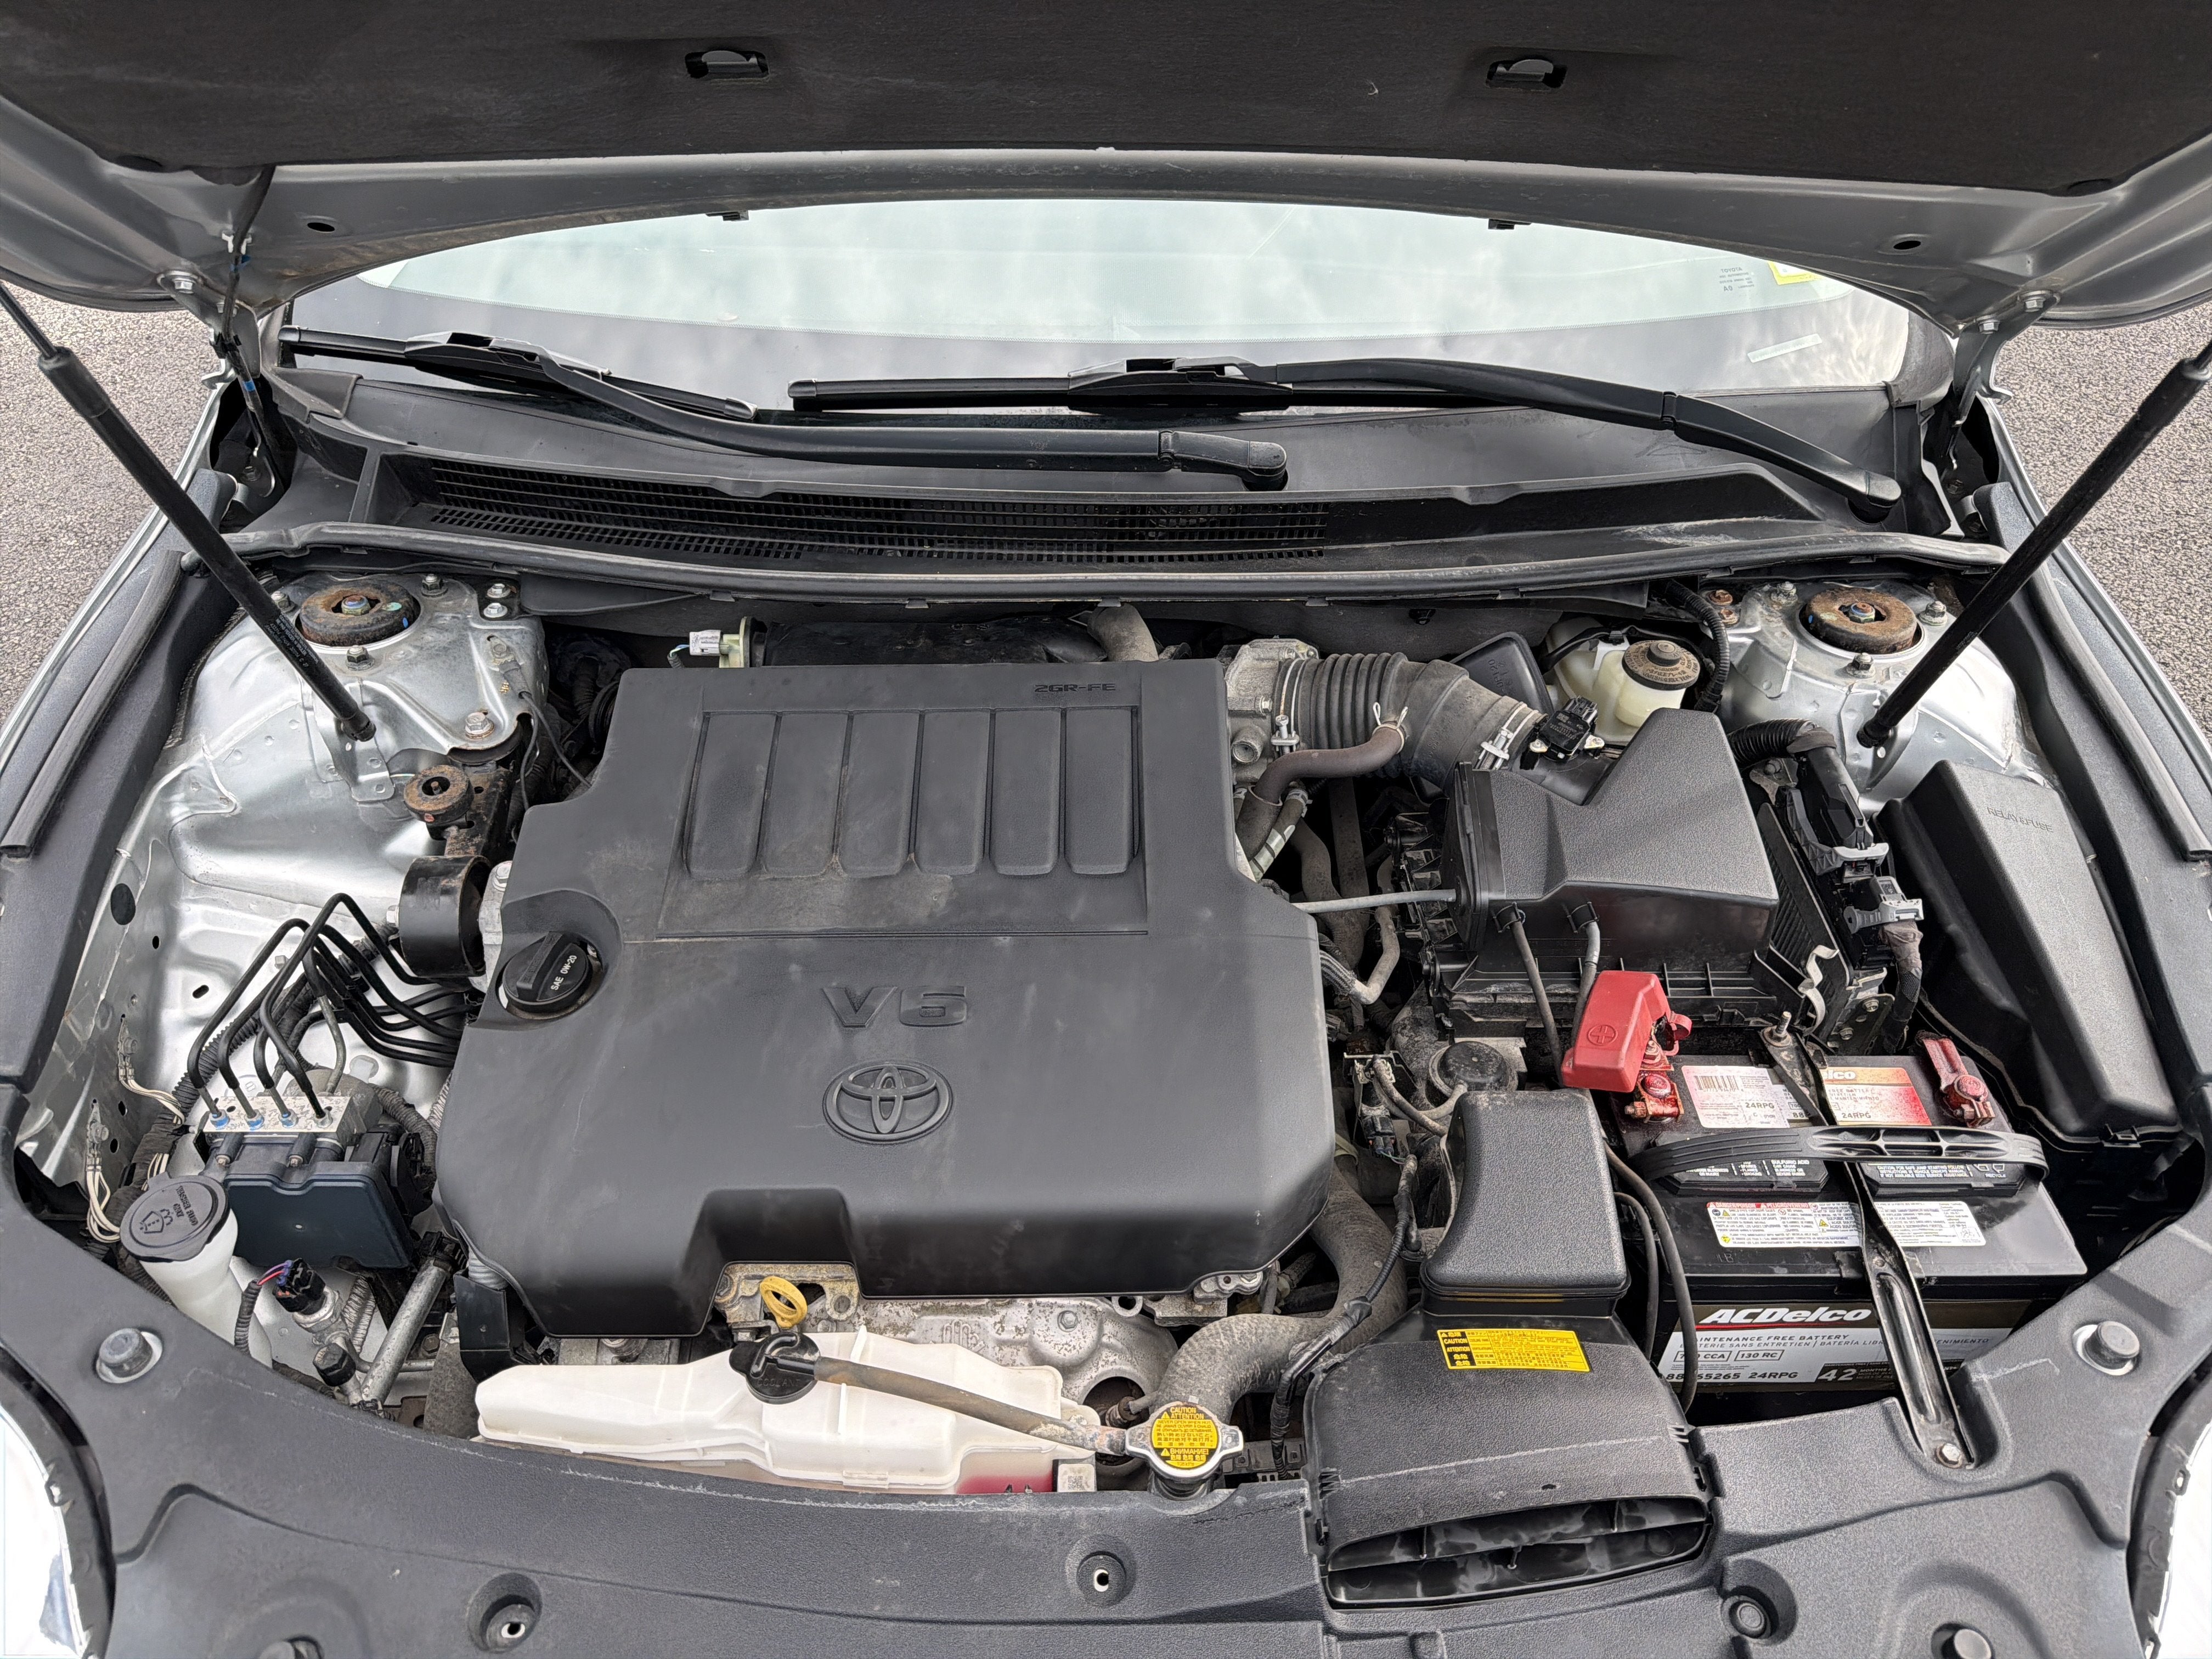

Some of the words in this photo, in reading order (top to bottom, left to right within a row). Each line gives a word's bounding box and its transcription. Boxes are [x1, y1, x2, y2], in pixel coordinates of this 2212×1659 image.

[1035, 684, 1116, 692] 2GR-FE
[550, 976, 564, 991] SAE
[560, 955, 577, 974] 0W-20
[822, 986, 967, 1028] V6
[1699, 1307, 1872, 1324] ACDelco
[1818, 1368, 1857, 1381] 42
[758, 1378, 801, 1387] COOLANT
